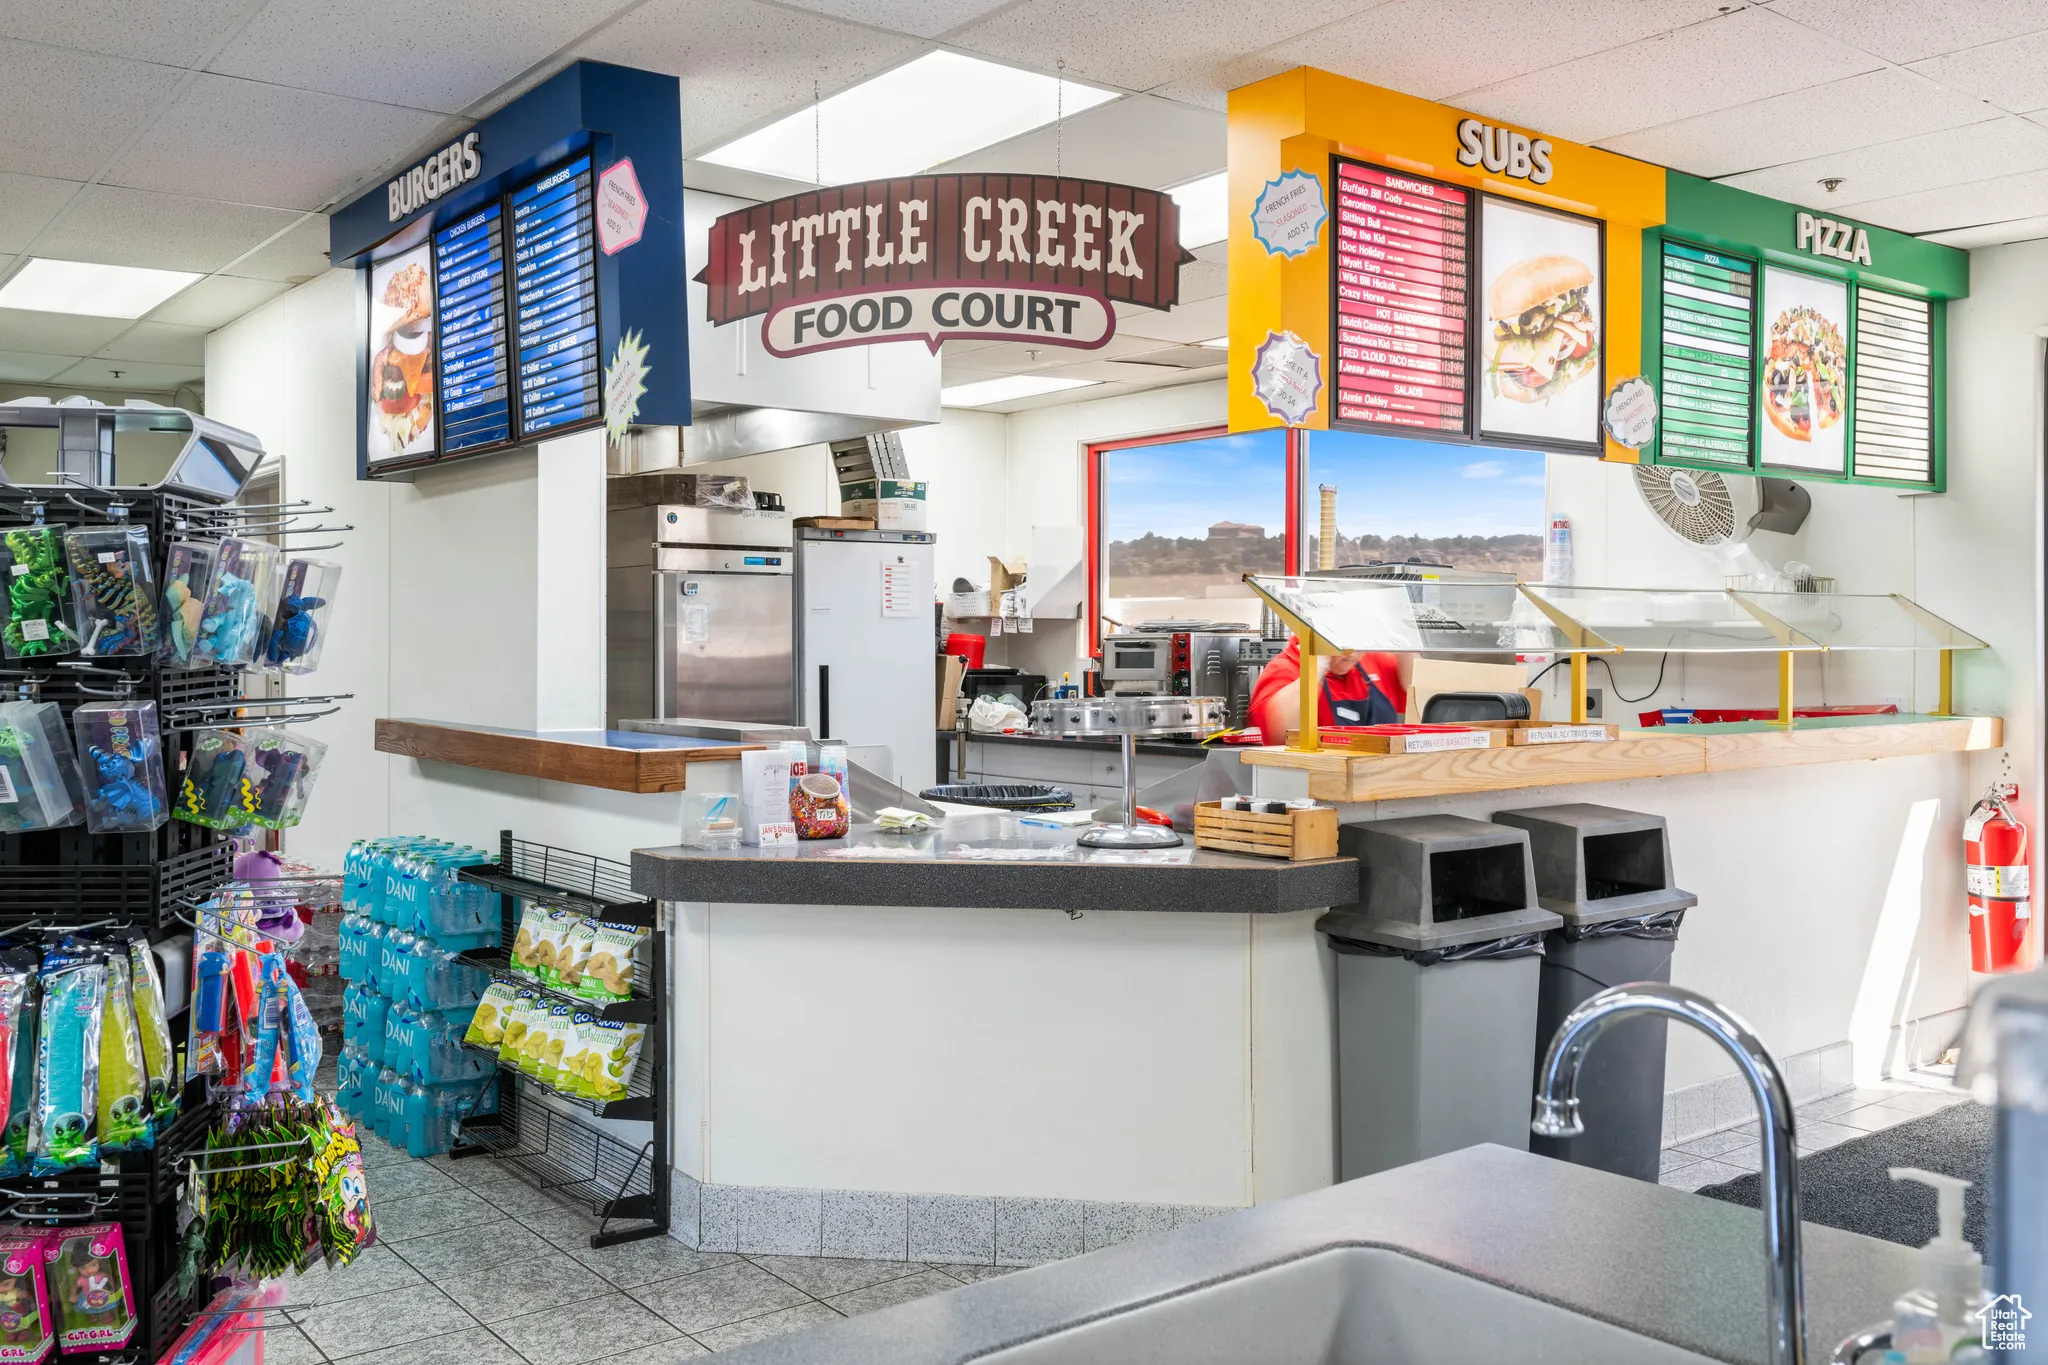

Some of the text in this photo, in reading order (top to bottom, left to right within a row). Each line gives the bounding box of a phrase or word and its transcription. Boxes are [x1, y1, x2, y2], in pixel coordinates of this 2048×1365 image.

[1457, 119, 1553, 185] SUBS
[388, 132, 481, 222] BURGERS
[537, 169, 570, 193] HAMBURGERS
[1385, 176, 1435, 196] SANDWICHES
[608, 179, 636, 207] FRENCH FRIES
[1265, 184, 1307, 215] FRENCH FRIES
[1342, 181, 1403, 205] Buffalo Bill Cody
[515, 206, 530, 219] Beretta
[607, 198, 629, 220] SEASONED
[1342, 195, 1377, 213] Geronimo
[606, 218, 617, 230] ADD
[1275, 203, 1308, 227] SEASONED
[1342, 211, 1365, 226] Sitting
[1367, 216, 1380, 229] Bull
[449, 213, 486, 238] CHICKEN BURGERS
[516, 222, 528, 234] Ruger
[1287, 221, 1309, 240] ADD $1
[1342, 225, 1357, 239] Billy
[1360, 229, 1372, 241] the
[1373, 232, 1386, 244] Kid
[516, 237, 526, 248] Colt
[738, 196, 1144, 295] LITTLE CREEK
[1796, 212, 1872, 266] PIZZA
[516, 249, 529, 262] Smith
[535, 241, 553, 255] Wesson
[1342, 241, 1385, 260] Doc Holiday
[1704, 253, 1720, 265] PIZZA
[517, 262, 537, 276] Hawkins
[1342, 256, 1380, 274] Wyatt Earp
[1682, 262, 1695, 273] Pizza
[457, 276, 470, 288] OTHER
[471, 268, 489, 282] OPTIONS
[518, 280, 531, 291] Henry
[1342, 271, 1397, 292] Wild Bill Hickok
[1682, 274, 1696, 284] Pizza
[520, 289, 544, 304] Winchester
[1340, 285, 1361, 300] Crazy
[1363, 291, 1385, 304] Horse
[521, 306, 540, 319] Magnum
[794, 292, 1080, 344] FOOD COURT
[1376, 308, 1441, 328] HOT SANDWICHES
[1680, 311, 1694, 321] YOUR
[1695, 314, 1706, 324] OWN
[1707, 317, 1722, 327] PIZZA
[520, 319, 543, 333] Remington
[1342, 315, 1362, 328] Butch
[1363, 319, 1392, 334] Cassidy
[520, 335, 541, 348] Derringer
[547, 335, 577, 354] SIDE ORDERS
[1342, 332, 1378, 347] Sundance
[1377, 338, 1391, 349] Kid
[1343, 347, 1359, 358] RED
[1361, 350, 1386, 362] CLOUD
[1388, 354, 1407, 366] TACO
[1343, 361, 1390, 378] Jesse James
[1394, 384, 1423, 397] SALADS
[1698, 377, 1712, 387] PIZZA
[1342, 391, 1389, 408] Annie Oakley
[1615, 387, 1645, 414] FRENCH FRIES
[1342, 406, 1373, 421] Calamity
[1375, 411, 1392, 422] Jane
[1624, 403, 1647, 423] SEASONED
[1632, 423, 1642, 433] ADD
[1728, 441, 1743, 450] PIZZA
[1408, 740, 1432, 750] RETURN
[1445, 737, 1471, 746] BASKETS
[1473, 736, 1490, 745] HERE
[1530, 729, 1603, 740] RETURN BLACK TRAYS HERE
[762, 825, 795, 835] JAN'S DINER
